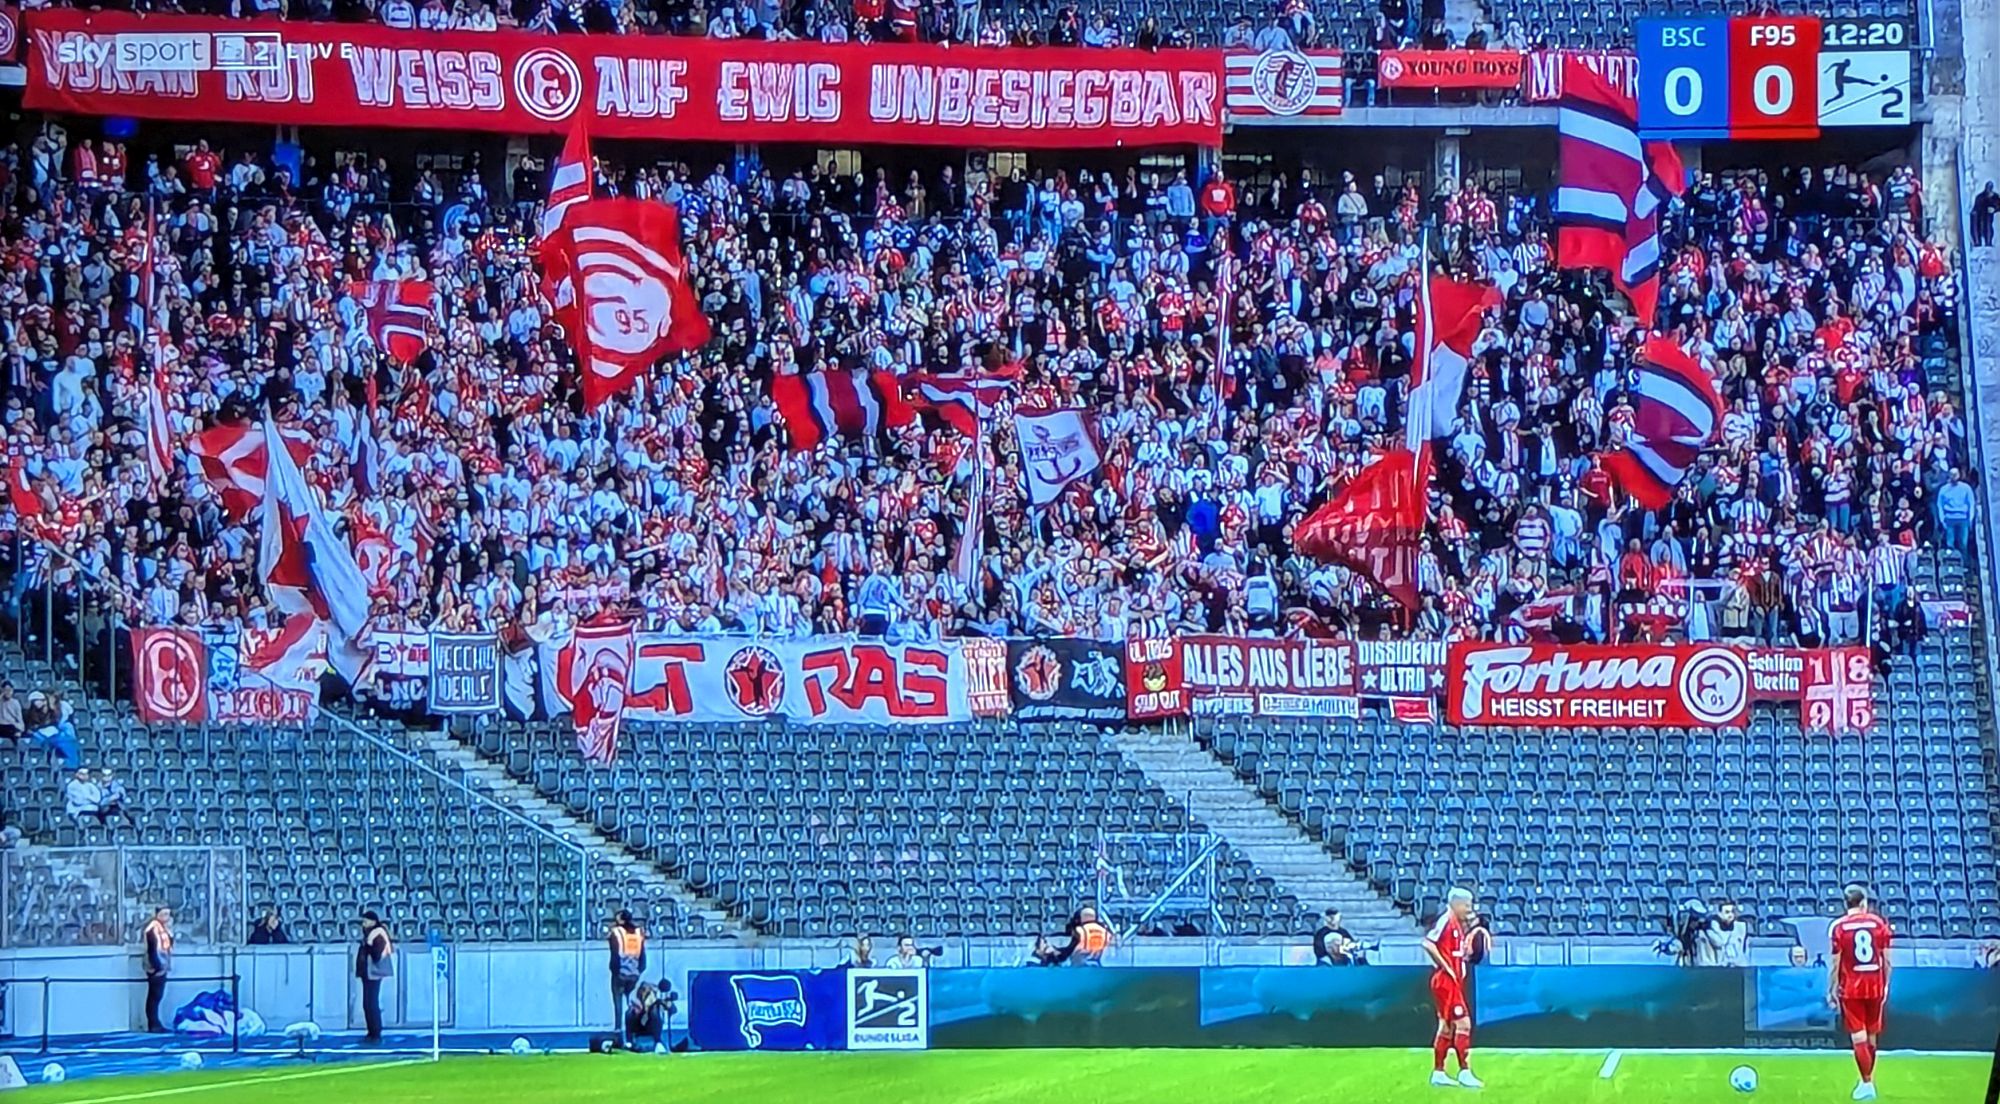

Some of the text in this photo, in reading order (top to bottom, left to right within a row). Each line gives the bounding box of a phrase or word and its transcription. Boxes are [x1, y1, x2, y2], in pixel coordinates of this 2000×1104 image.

[1406, 59, 1519, 76] YOUNG BOYS
[350, 44, 505, 112] WEISS
[593, 56, 688, 119] AUF
[717, 61, 842, 123] EWIG
[869, 64, 1217, 129] UNBESIEGBAR
[614, 308, 650, 334] 95
[1183, 643, 1354, 689] ALLES AUS LIEBE
[1357, 640, 1447, 665] DISSIDENTI
[1461, 646, 1676, 720] Fortuna
[1491, 697, 1667, 719] HEISST FREIHEIT
[1854, 927, 1874, 964] 8
